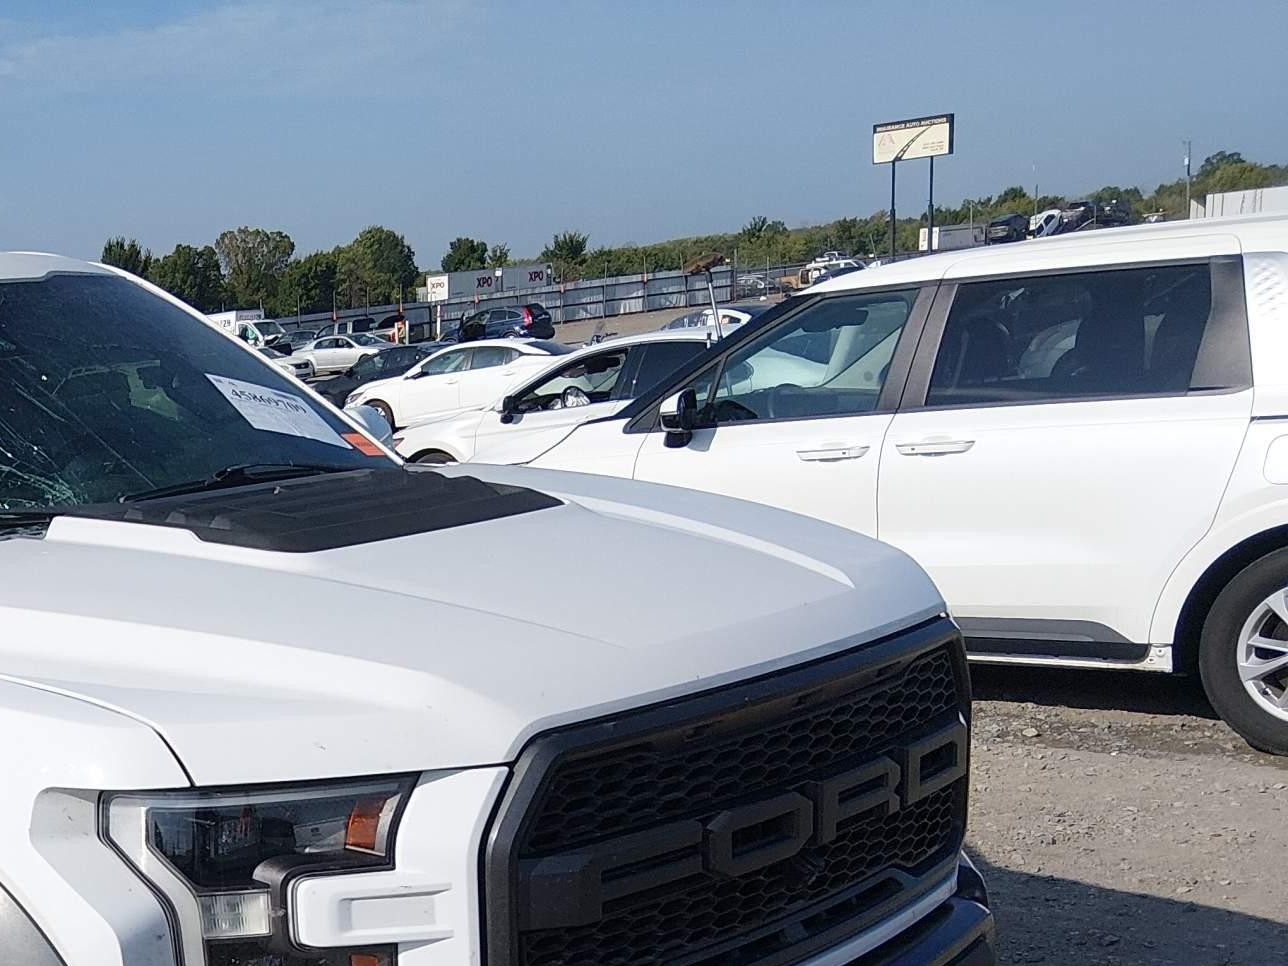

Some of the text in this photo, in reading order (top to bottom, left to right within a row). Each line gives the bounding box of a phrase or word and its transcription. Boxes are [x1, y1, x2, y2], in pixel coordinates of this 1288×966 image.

[476, 276, 493, 289] XPO
[528, 271, 544, 283] XPO
[430, 281, 445, 290] XPO
[524, 727, 968, 931] FORD
